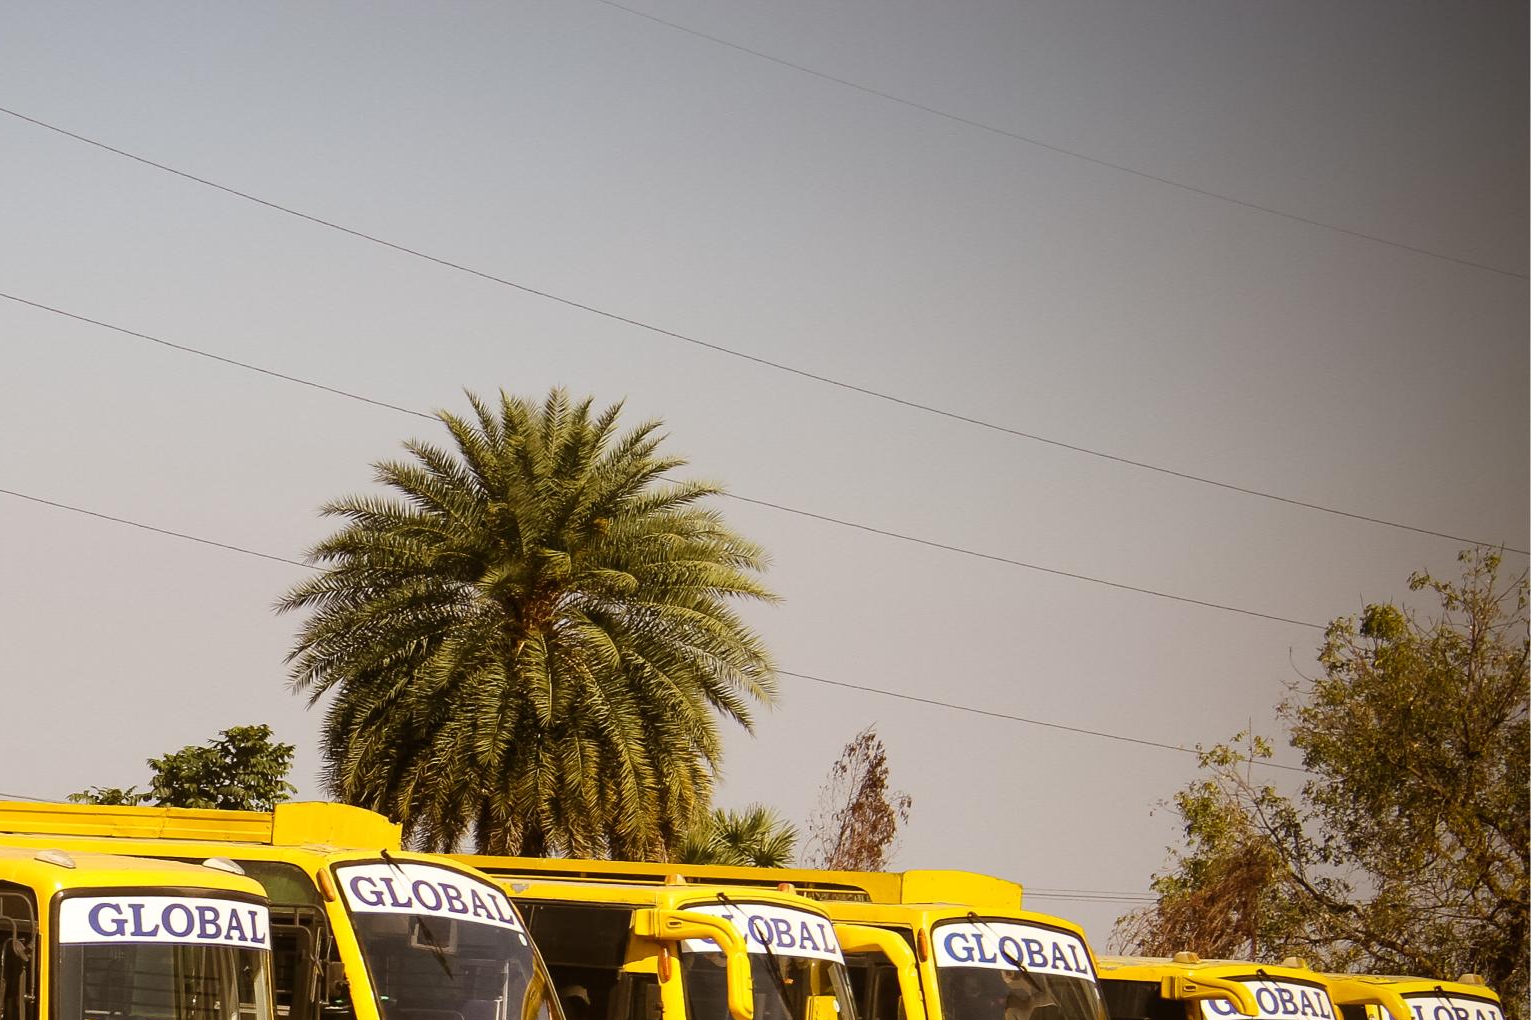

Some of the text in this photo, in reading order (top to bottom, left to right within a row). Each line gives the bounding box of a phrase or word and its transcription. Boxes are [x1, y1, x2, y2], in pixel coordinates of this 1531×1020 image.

[350, 876, 515, 925] GLOBAL
[88, 902, 266, 944] GLOBAL
[700, 914, 836, 954] OBAL
[944, 932, 1088, 975] GLOBAL
